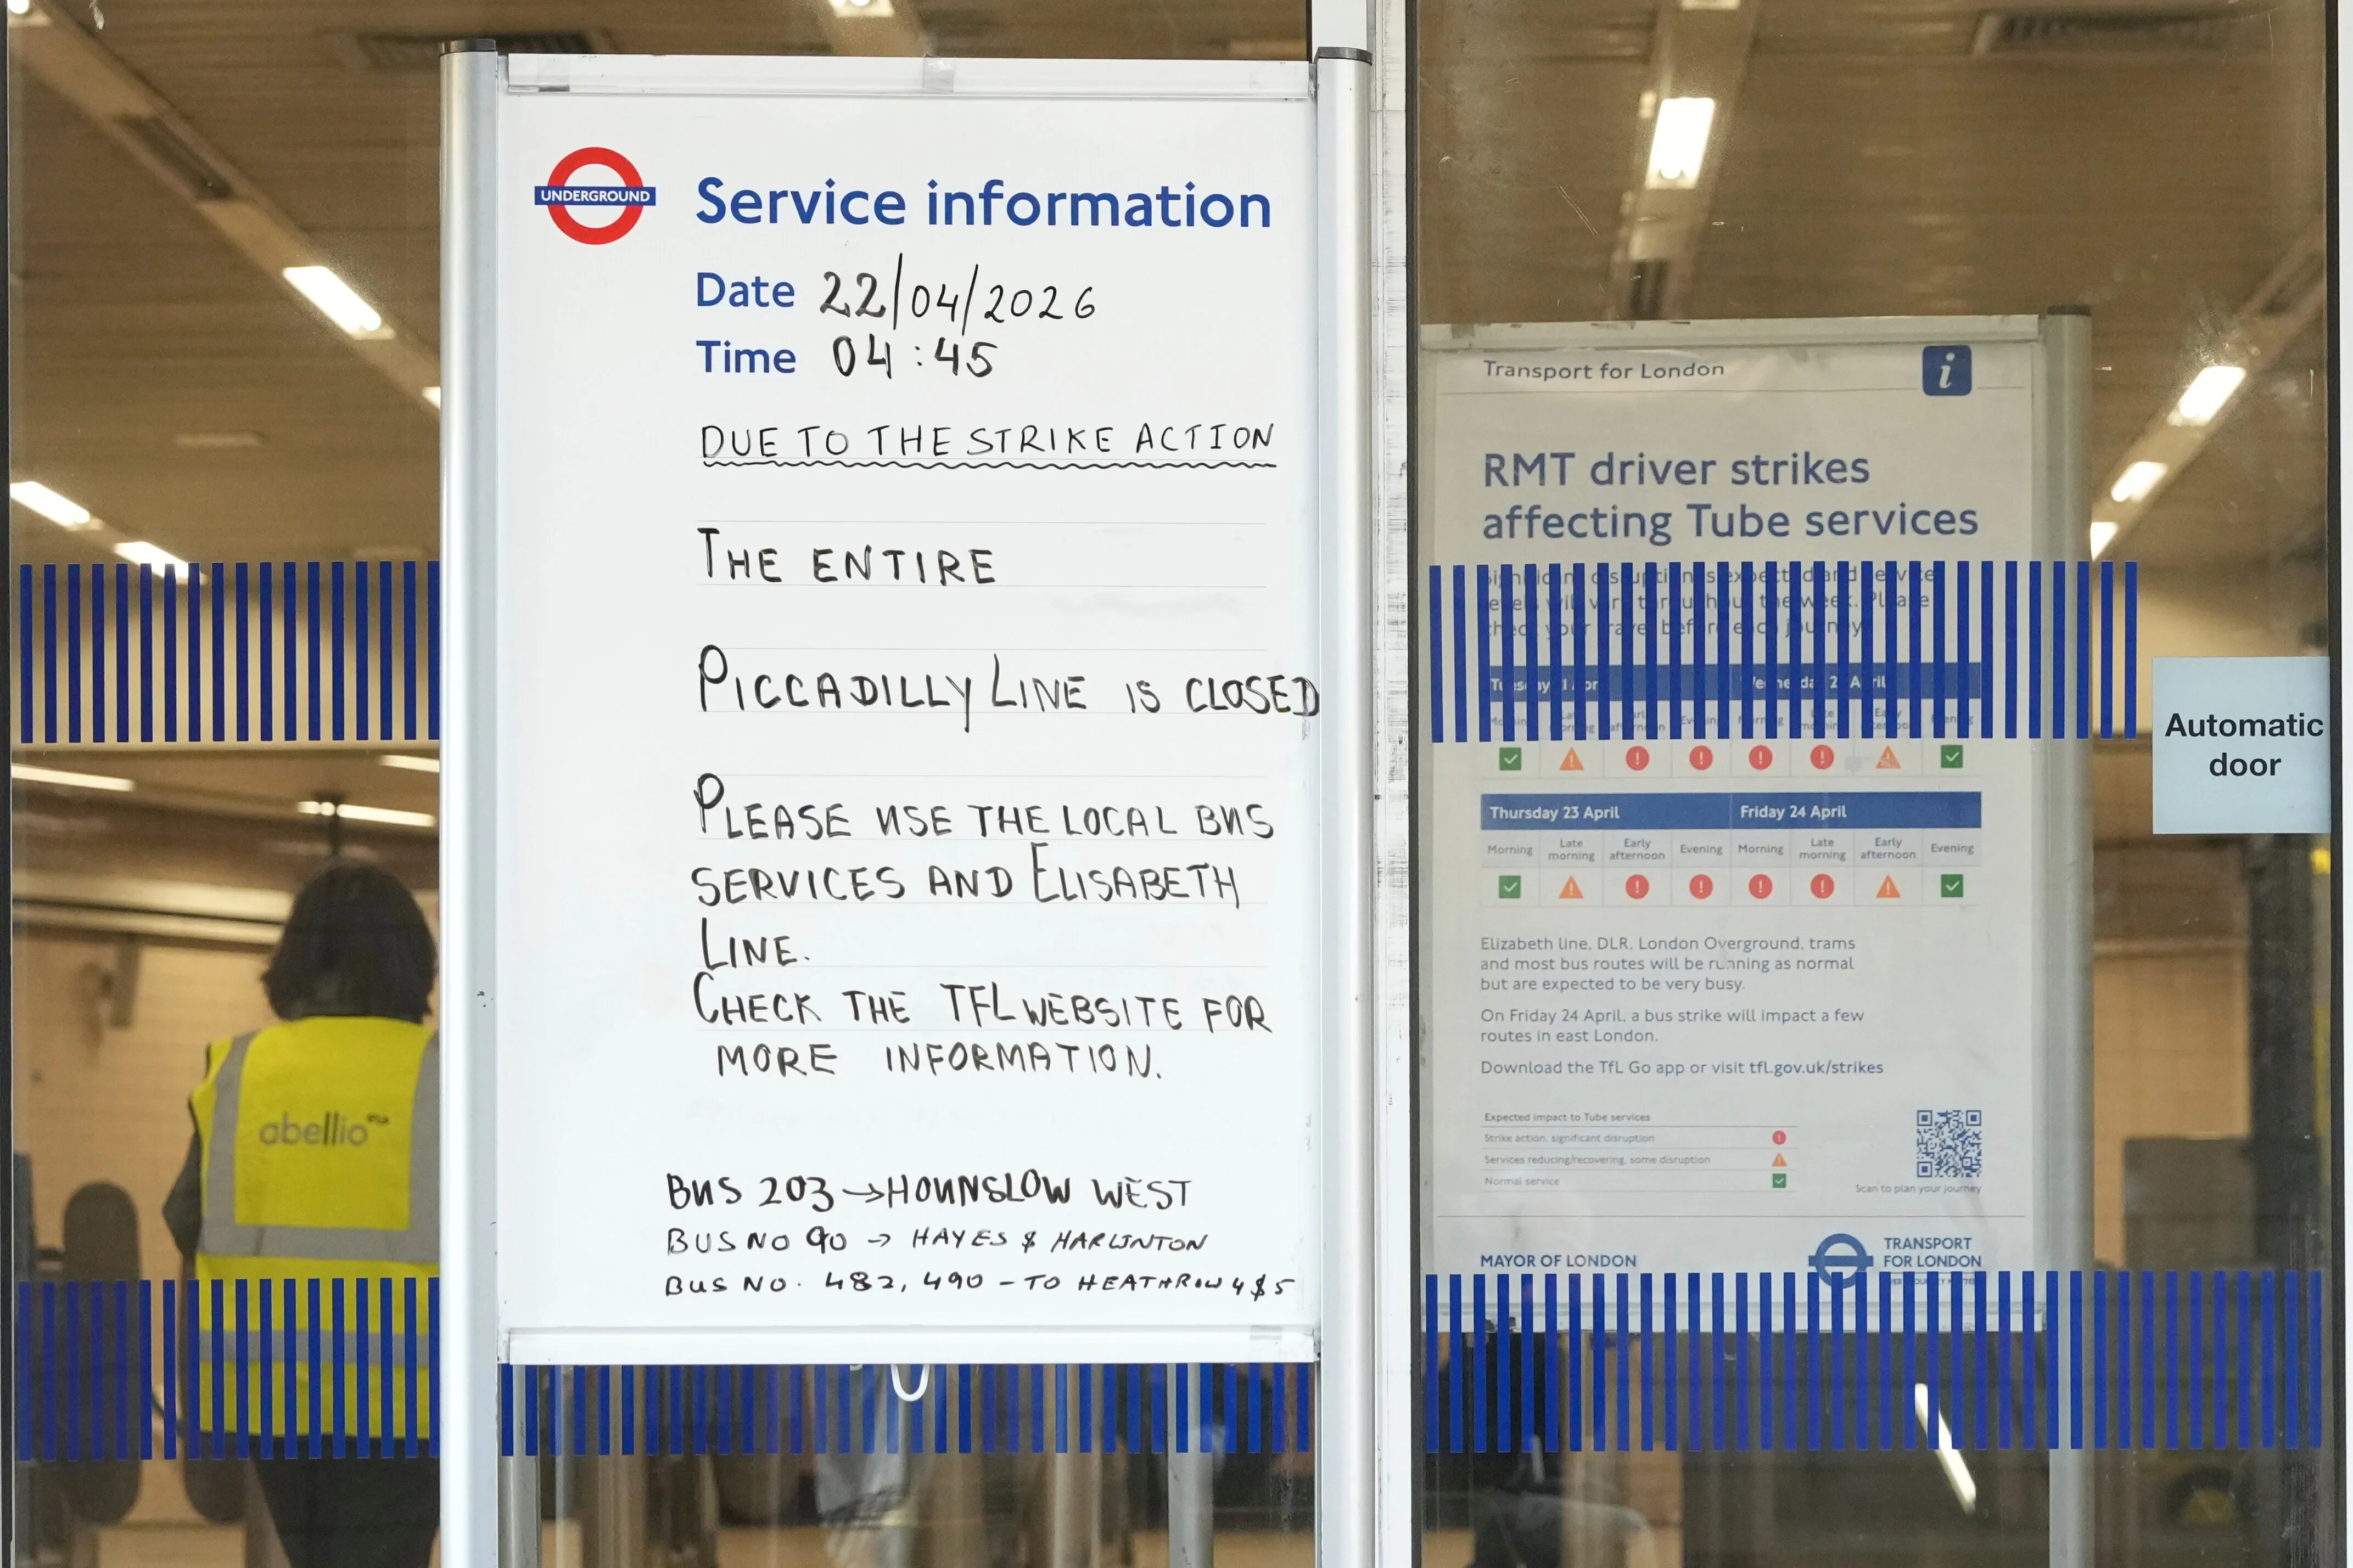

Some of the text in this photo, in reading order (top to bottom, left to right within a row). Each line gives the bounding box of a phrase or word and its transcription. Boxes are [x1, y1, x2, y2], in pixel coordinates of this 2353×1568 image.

[541, 190, 650, 202] UNDERGROUND
[696, 177, 1271, 227] Service information
[697, 272, 795, 307] Date
[819, 253, 1095, 335] 22/04/2026
[696, 340, 796, 374] Time
[1483, 359, 1724, 381] Transport for London
[702, 423, 1274, 458] DUE TO THE STRIKE ACTION
[1484, 451, 1870, 487] RMT driver strikes
[1483, 502, 1979, 547] affecting Tube services
[697, 527, 996, 586] THE ENTIRE
[698, 644, 1320, 733] PICCADILLY LINE IS CLOSED
[2165, 712, 2324, 737] Automatic
[2209, 752, 2282, 776] door
[693, 773, 1274, 840] PLEASE USE THE LOCAL BUS
[1489, 805, 1620, 822] Thursday 23 April
[1741, 805, 1847, 820] Friday 24 April
[1560, 839, 1583, 848] Late
[1624, 839, 1651, 849] Early
[1680, 845, 1723, 856] Evening
[1738, 845, 1784, 856] Morning
[1811, 838, 1834, 847] Late
[1875, 838, 1902, 848] Early
[1931, 844, 1974, 855] Evening
[1487, 845, 1533, 857] Morning
[1548, 851, 1595, 862] morning
[1610, 851, 1665, 861] afternoon
[1799, 851, 1846, 861] morning
[1861, 850, 1916, 860] afternoon
[691, 841, 1240, 909] SERVICES AND ELISABETH
[701, 917, 810, 970] LINE.
[1481, 937, 1554, 950] Elizabeth
[1639, 937, 1698, 950] London
[1705, 936, 1804, 953] Overground,
[1809, 938, 1856, 949] trams
[1481, 958, 1509, 970] and
[1515, 960, 1555, 970] most
[1561, 958, 1588, 970] bus
[1594, 960, 1645, 970] routes
[1650, 957, 1679, 970] will
[1685, 957, 1704, 970] be
[1775, 960, 1791, 969] as
[1796, 957, 1855, 969] normal
[1481, 977, 1745, 993] but are expected to be very busy.
[693, 971, 1273, 1033] CHECK THE TFL WEBSITE FOR
[1481, 1009, 1504, 1022] On
[1510, 1009, 1556, 1025] Friday
[1562, 1009, 1578, 1021] 24
[1632, 1012, 1640, 1021] a
[1645, 1009, 1673, 1021] bus
[1678, 1009, 1722, 1022] strike
[1727, 1009, 1756, 1021] will
[1761, 1009, 1817, 1025] impact
[1822, 1012, 1829, 1021] a
[1834, 1009, 1864, 1021] few
[1481, 1029, 1659, 1042] routes in east London.
[718, 1042, 1162, 1079] MORE INFORMATION.
[1481, 1059, 1884, 1077] Download the TfL Go app or visit tfl.gov.uk/strikes
[1484, 1113, 1531, 1123] Expected
[1533, 1113, 1567, 1123] impact
[1584, 1113, 1608, 1122] Tube
[1610, 1113, 1651, 1122] services
[260, 1110, 368, 1147] abellio
[1484, 1134, 1512, 1143] Strike
[1551, 1134, 1601, 1144] significant
[1604, 1134, 1655, 1144] disruption
[1484, 1155, 1525, 1165] Services
[1660, 1156, 1710, 1164] disruption
[1484, 1177, 1522, 1186] Normal
[1856, 1184, 1878, 1193] Scan
[1894, 1184, 1916, 1194] plan
[1919, 1185, 1941, 1194] your
[1943, 1184, 1981, 1194] journey
[666, 1168, 1192, 1212] BUS 203 HOUNSLOW WEST
[667, 1228, 736, 1256] BUS
[747, 1232, 790, 1251] NO
[806, 1226, 847, 1254] 90
[912, 1227, 1008, 1249] HAYES
[1884, 1237, 1972, 1250] TRANSPORT
[1481, 1255, 1637, 1267] MAYOR OF LONDON
[1884, 1255, 1981, 1267] FOR LONDON
[666, 1275, 727, 1296] BUS
[923, 1272, 983, 1291] 490
[1024, 1274, 1061, 1291] TO
[1078, 1273, 1223, 1291] HEATHROW
[1232, 1278, 1244, 1295] 4
[1274, 1279, 1295, 1294] 5
